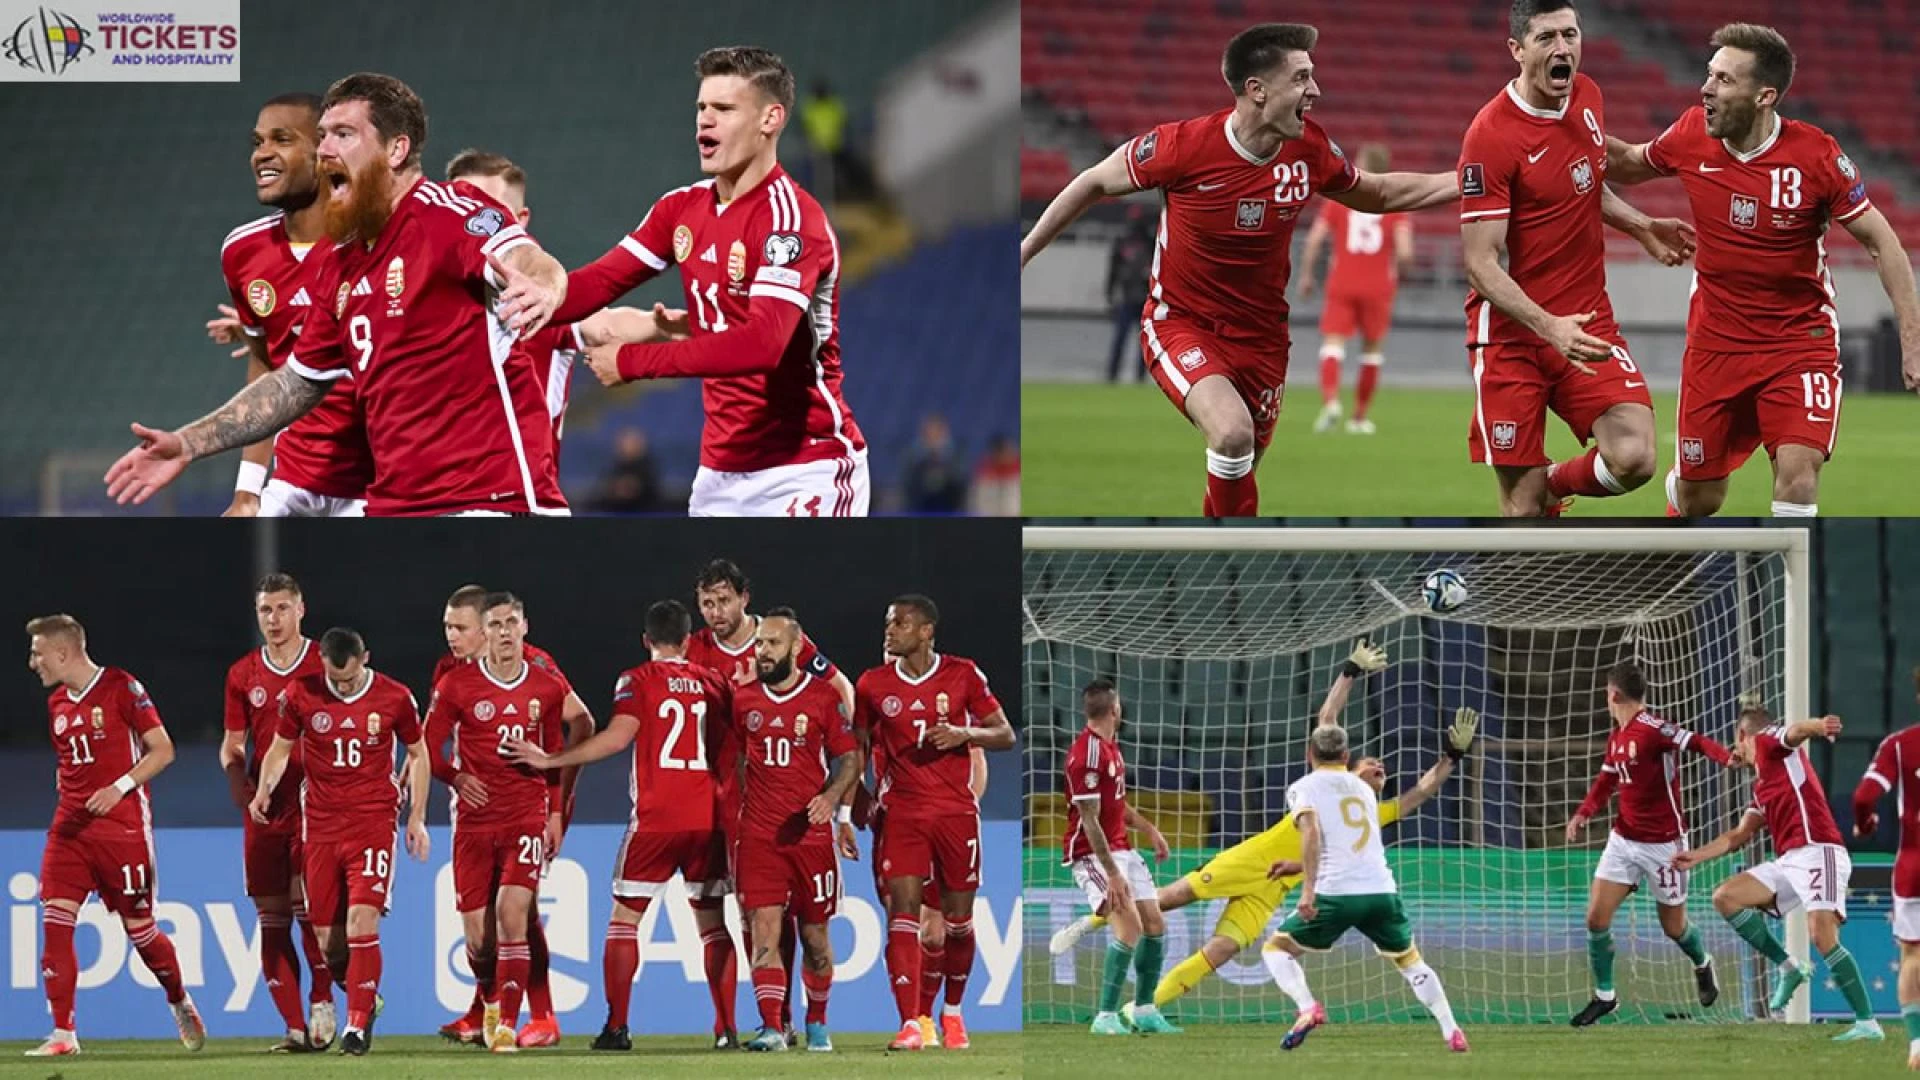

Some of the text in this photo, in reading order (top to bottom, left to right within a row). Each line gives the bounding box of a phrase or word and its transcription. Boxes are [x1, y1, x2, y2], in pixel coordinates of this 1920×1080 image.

[1583, 108, 1603, 147] 9
[1273, 160, 1310, 203] 23
[1769, 167, 1802, 209] 13
[690, 278, 729, 333] 11
[350, 314, 373, 371] 9
[1611, 345, 1637, 373] 9
[1801, 372, 1831, 409] 13
[69, 733, 95, 766] 11
[658, 698, 709, 770] 21
[912, 719, 927, 749] 7
[332, 736, 361, 767] 16
[763, 735, 790, 767] 10
[1339, 796, 1371, 854] 9
[361, 847, 389, 878] 16
[518, 835, 542, 865] 20
[966, 838, 977, 869] 7
[121, 863, 149, 896] 11
[813, 869, 834, 903] 10
[1655, 866, 1677, 889] 11
[1808, 868, 1823, 890] 2
